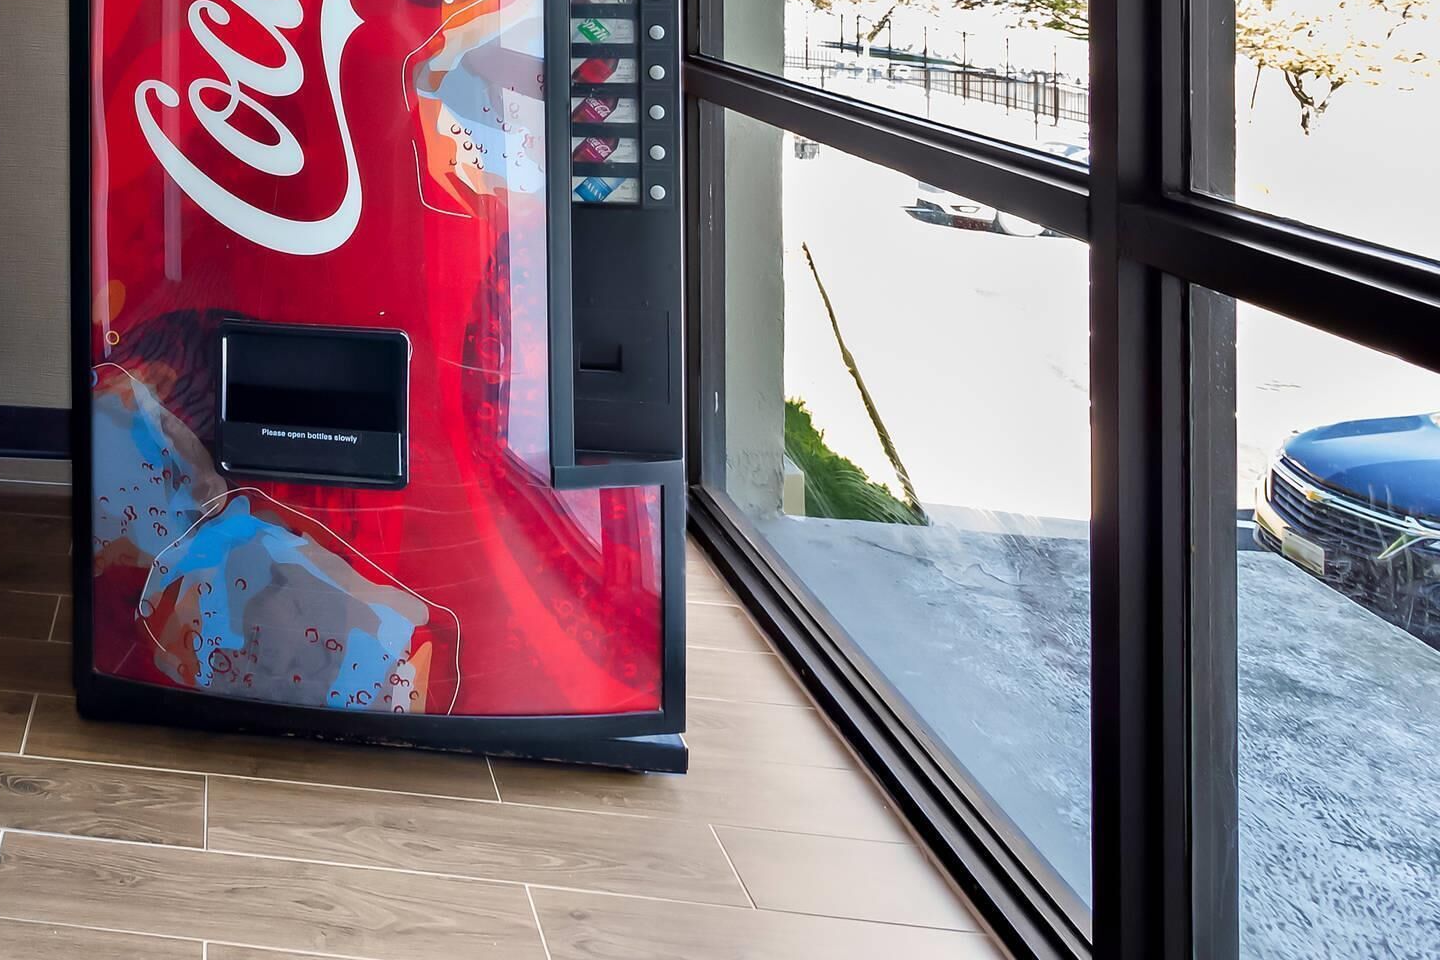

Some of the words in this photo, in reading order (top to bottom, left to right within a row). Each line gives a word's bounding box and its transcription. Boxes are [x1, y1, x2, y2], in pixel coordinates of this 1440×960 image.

[262, 428, 286, 437] Please
[287, 431, 306, 440] open
[307, 431, 333, 441] bottles
[334, 434, 358, 444] slowly
